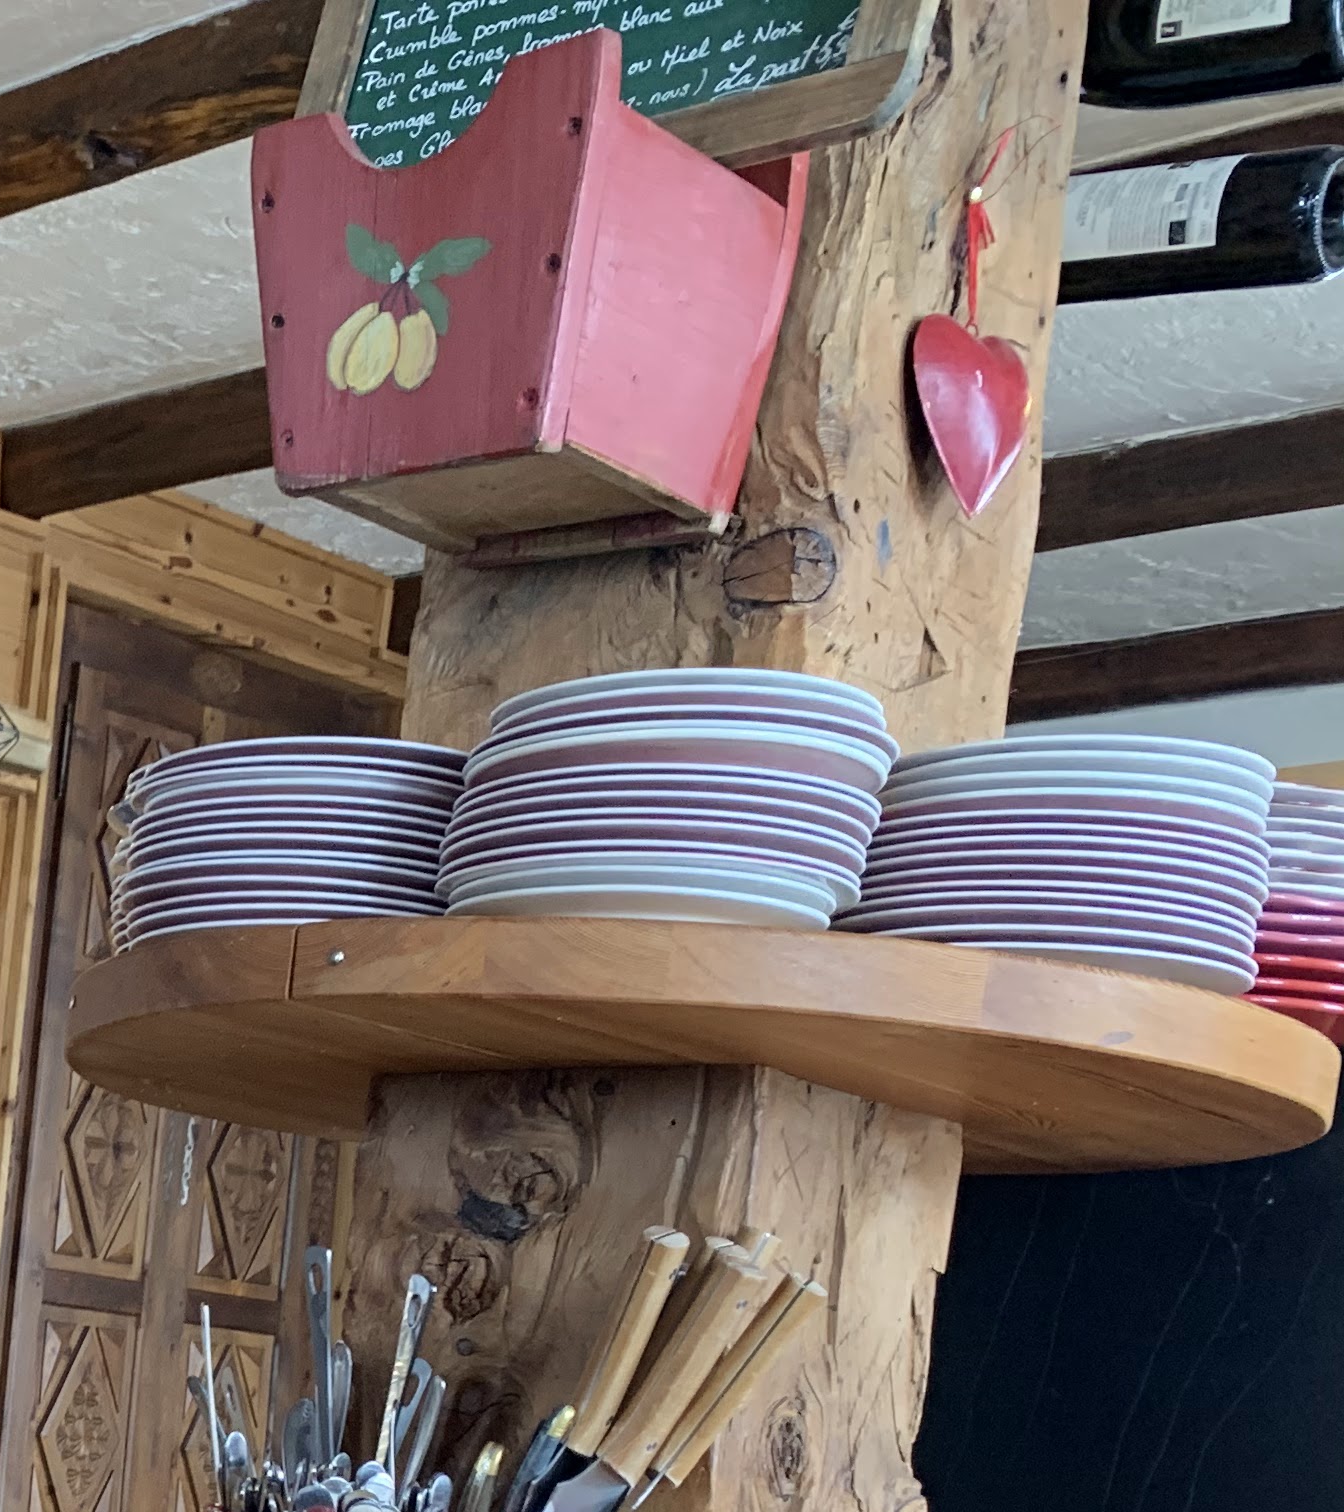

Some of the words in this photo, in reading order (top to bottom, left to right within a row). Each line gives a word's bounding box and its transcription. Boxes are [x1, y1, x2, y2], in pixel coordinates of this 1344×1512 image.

[379, 2, 440, 34] Tarte
[361, 71, 406, 92] Pain
[414, 59, 439, 79] de
[619, 8, 673, 32] blanc
[369, 24, 463, 63] Crumble
[347, 112, 435, 139] Fromage
[627, 59, 652, 76] ou
[661, 36, 711, 75] Miel
[720, 28, 745, 52] et
[752, 19, 804, 45] Noix
[713, 54, 756, 93] La
[376, 90, 397, 111] et
